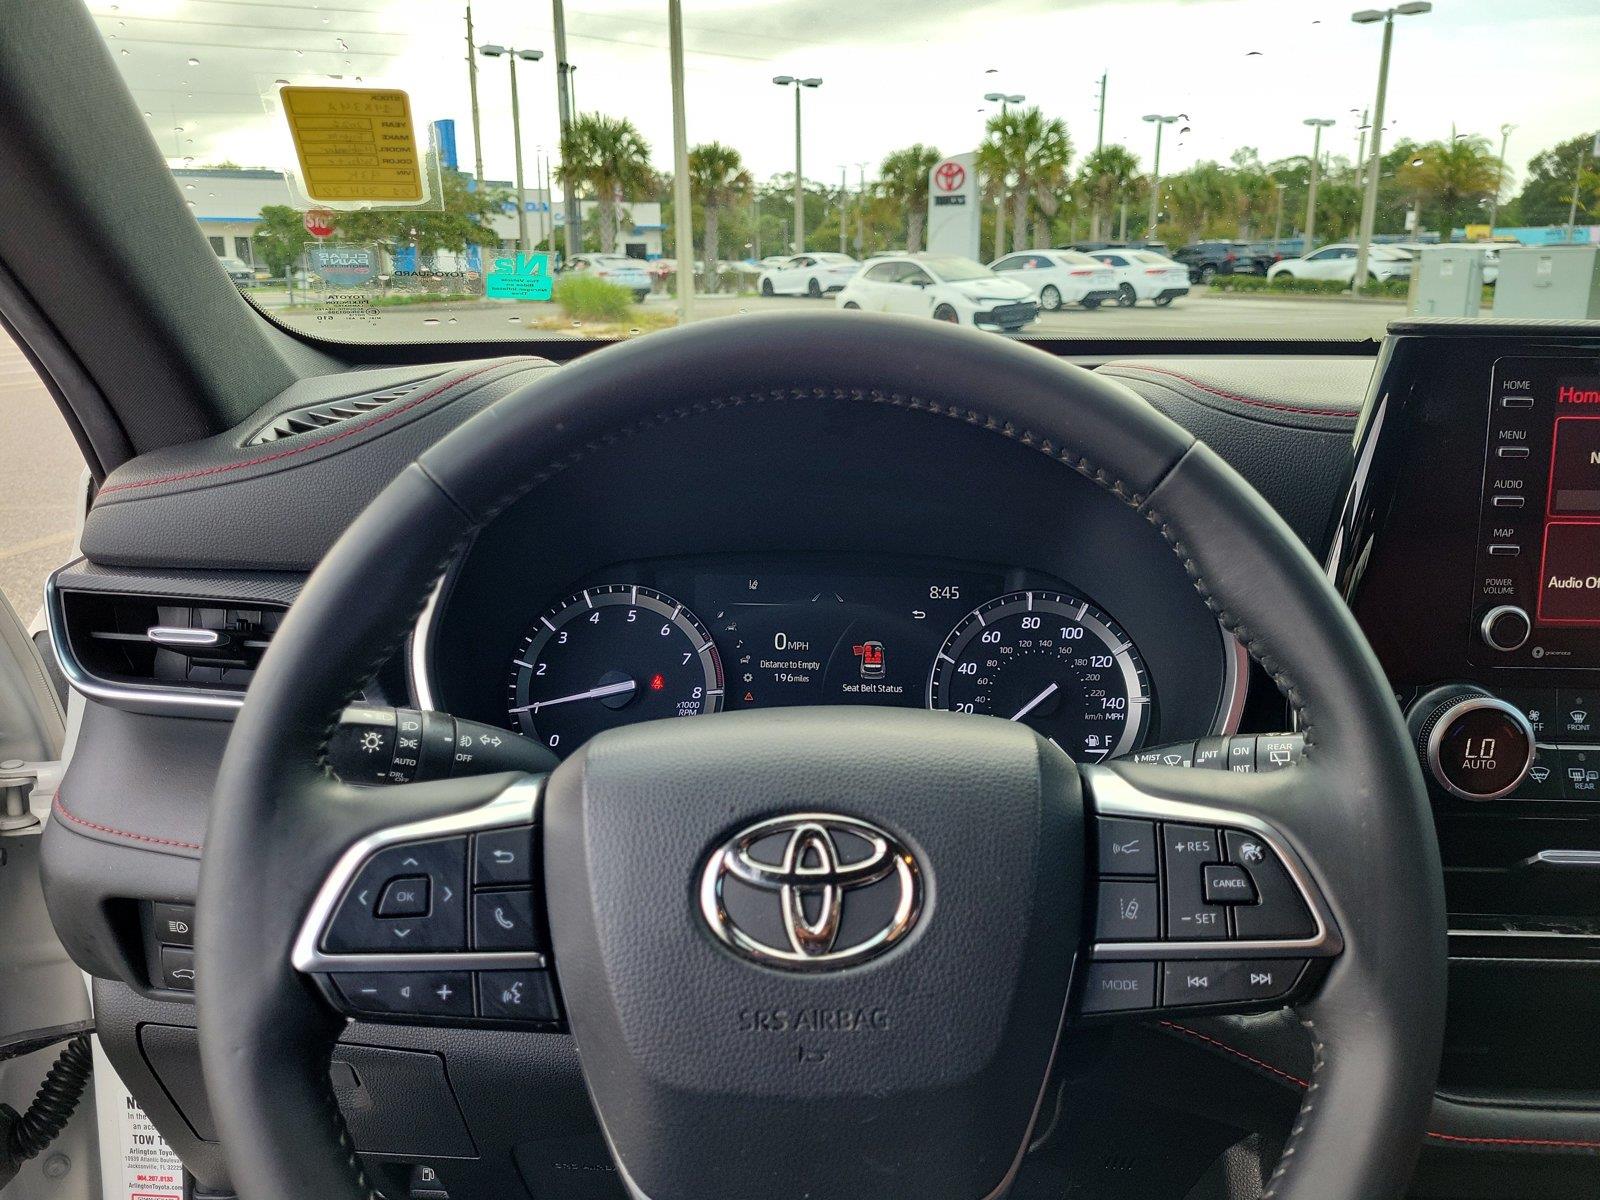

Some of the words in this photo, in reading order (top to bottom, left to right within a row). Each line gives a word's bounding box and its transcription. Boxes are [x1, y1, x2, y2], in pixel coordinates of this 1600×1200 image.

[1503, 380, 1530, 390] HOME
[1558, 386, 1600, 403] Hom
[1498, 430, 1526, 440] MENU
[1494, 480, 1523, 489] AUDIO
[1493, 528, 1514, 538] MAP
[1485, 578, 1512, 586] POWER
[1548, 576, 1583, 588] Audio
[1585, 576, 1600, 588] Of
[930, 586, 960, 600] 8:45
[1483, 586, 1514, 594] VOLUME
[590, 612, 600, 624] 4
[627, 610, 636, 622] 5
[1021, 617, 1040, 629] 80
[660, 624, 670, 636] 6
[1060, 627, 1084, 640] 100
[558, 632, 568, 644] 3
[774, 632, 786, 650] 0
[788, 641, 810, 650] MPH
[982, 631, 1001, 644] 60
[1018, 640, 1032, 648] 120
[1039, 640, 1053, 648] 140
[1058, 646, 1072, 654] 160
[682, 652, 692, 666] 7
[986, 660, 998, 668] 80
[1074, 658, 1088, 666] 180
[1090, 656, 1114, 668] 120
[536, 664, 546, 676] 2
[760, 660, 788, 668] Distance
[798, 661, 820, 670] Empty
[958, 662, 977, 675] 40
[977, 678, 988, 686] 60
[1085, 674, 1100, 682] 200
[692, 687, 702, 699] 8
[842, 684, 860, 692] Seat
[861, 684, 877, 692] Belt
[878, 684, 903, 693] Status
[676, 701, 700, 709] x1000
[974, 696, 986, 704] 40
[1100, 698, 1125, 710] 140
[955, 703, 974, 714] 20
[1084, 712, 1103, 720] km/h
[1106, 712, 1124, 720] MPH
[550, 734, 560, 746] 0
[1105, 735, 1113, 746] F
[1202, 750, 1219, 758] INT
[1233, 747, 1250, 756] ON
[394, 758, 416, 766] AUTO
[455, 753, 472, 762] OFF
[1141, 754, 1161, 762] MIST
[1233, 764, 1250, 772] INT
[1462, 760, 1496, 770] AUTO
[1212, 878, 1246, 888] CANCEL
[396, 892, 414, 902] OK
[1102, 980, 1138, 990] MODE
[738, 1008, 790, 1032] SRS
[794, 1008, 890, 1032] AIRBAG
[132, 1134, 154, 1145] TOW
[130, 1147, 157, 1157] Arlington
[128, 1182, 182, 1190] ArlingtonToyota.com
